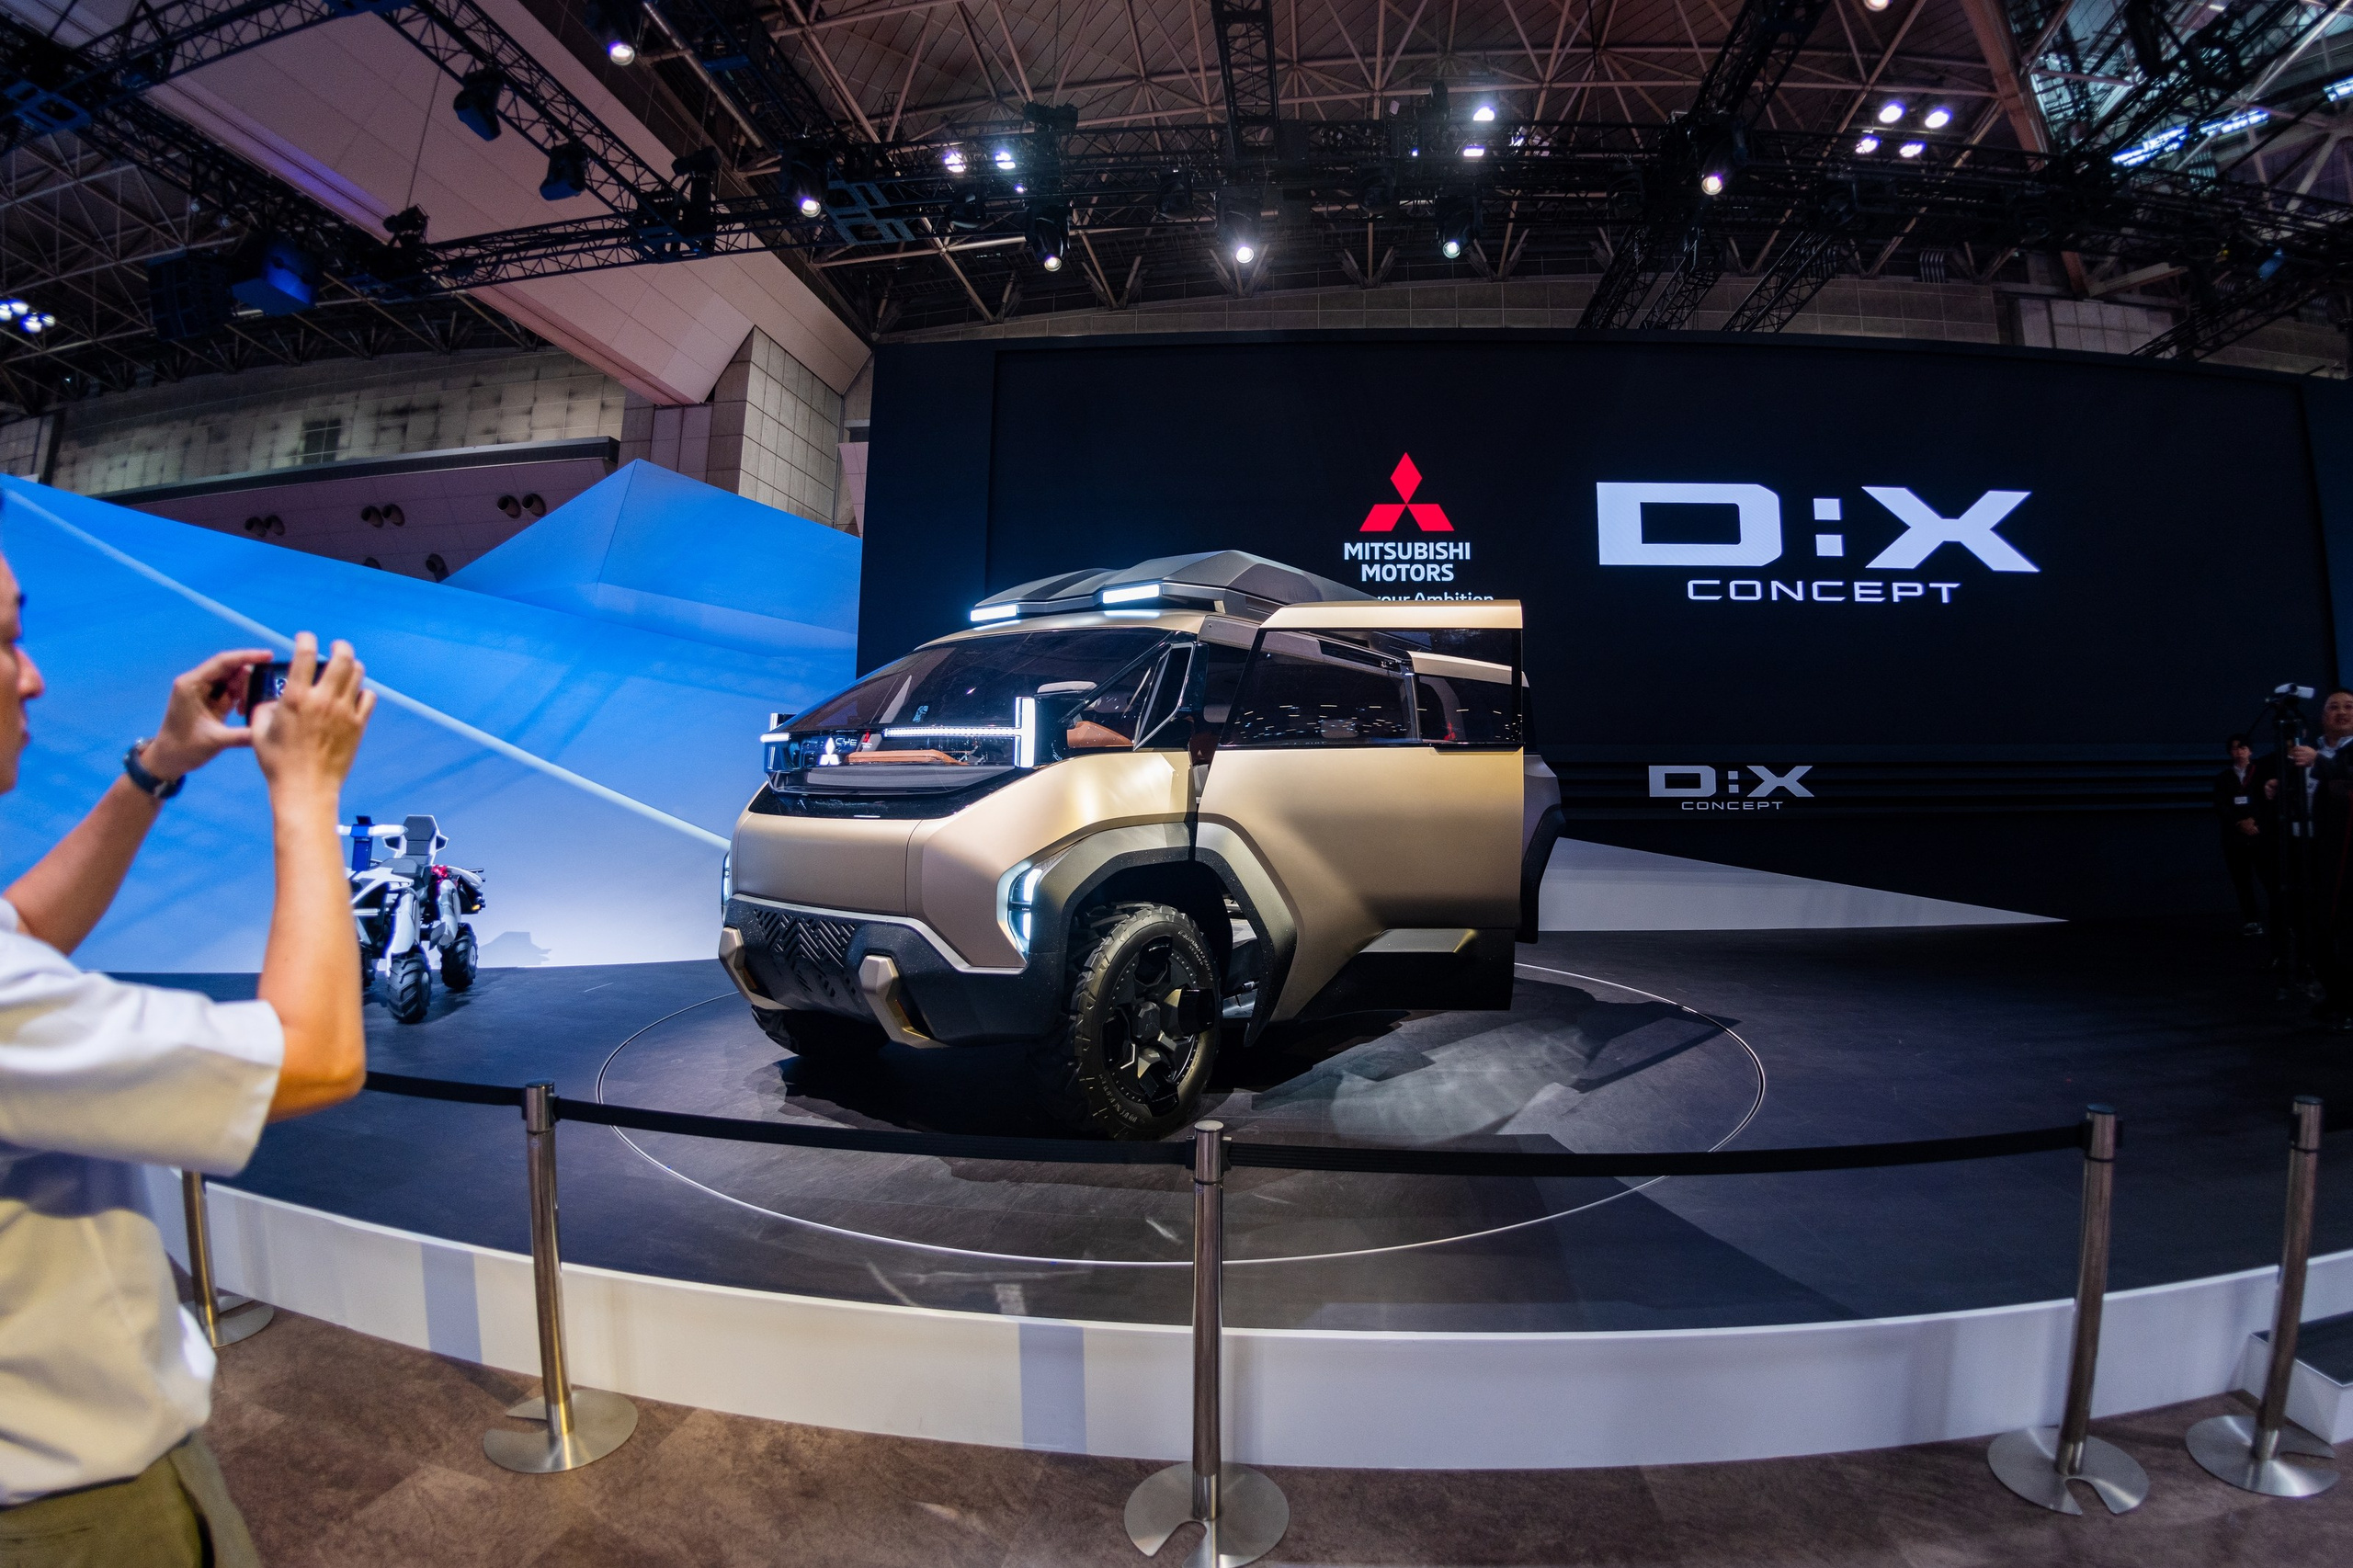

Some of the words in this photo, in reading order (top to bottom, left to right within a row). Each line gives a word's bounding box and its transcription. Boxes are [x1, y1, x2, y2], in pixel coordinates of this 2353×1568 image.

[1597, 482, 2040, 573] D:X
[1344, 541, 1472, 561] MITSUBISHI
[1361, 563, 1455, 582] MOTORS
[1687, 580, 1961, 604] CONCEPT
[1648, 765, 1815, 798] D:X
[1681, 801, 1783, 811] CONCEPT
